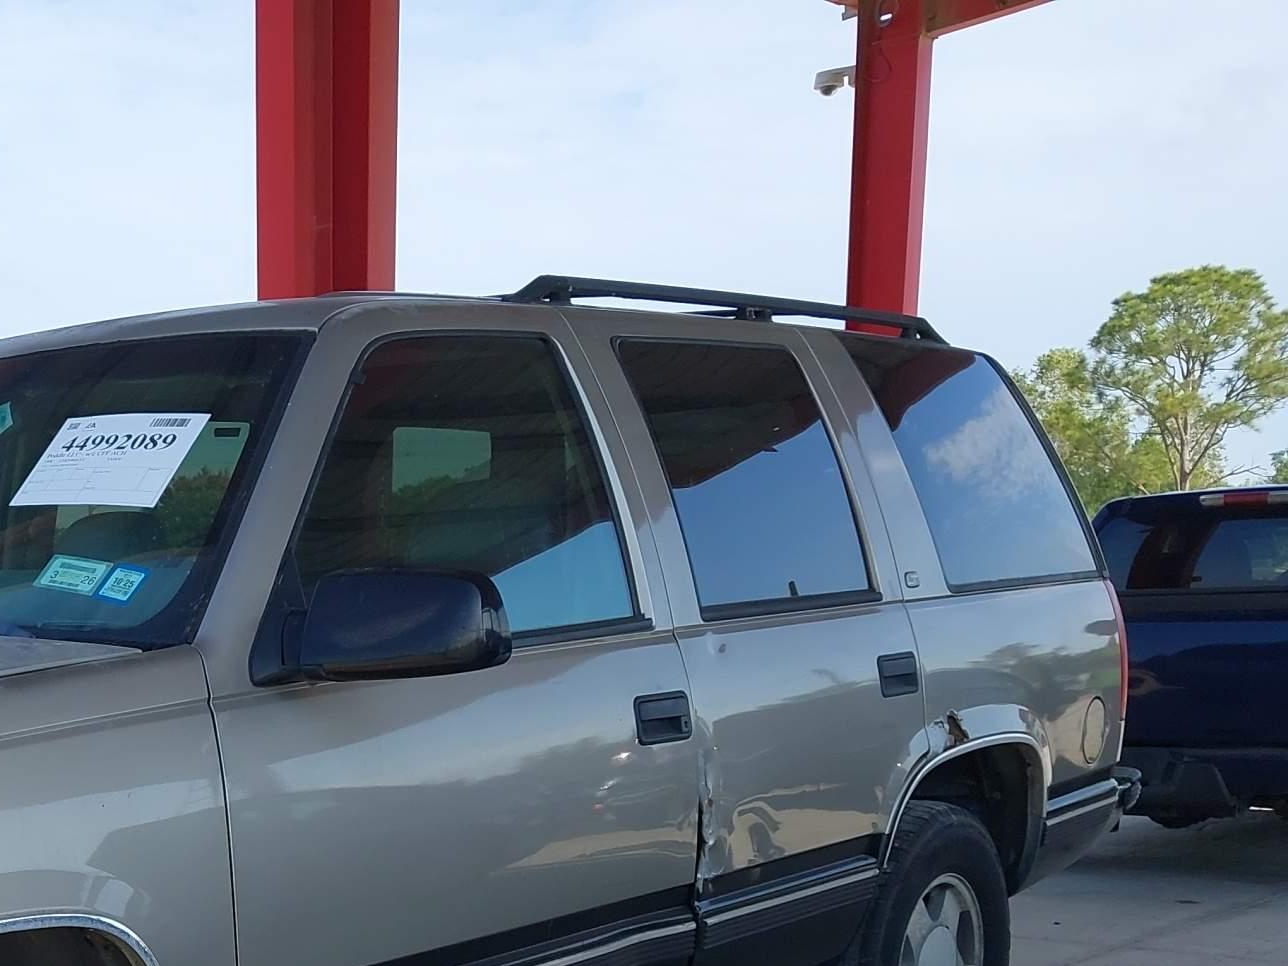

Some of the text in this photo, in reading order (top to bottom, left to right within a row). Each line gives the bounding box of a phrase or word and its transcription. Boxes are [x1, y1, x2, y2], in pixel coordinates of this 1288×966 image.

[62, 433, 178, 452] 44992089
[50, 570, 59, 579] 3
[79, 575, 97, 586] 26
